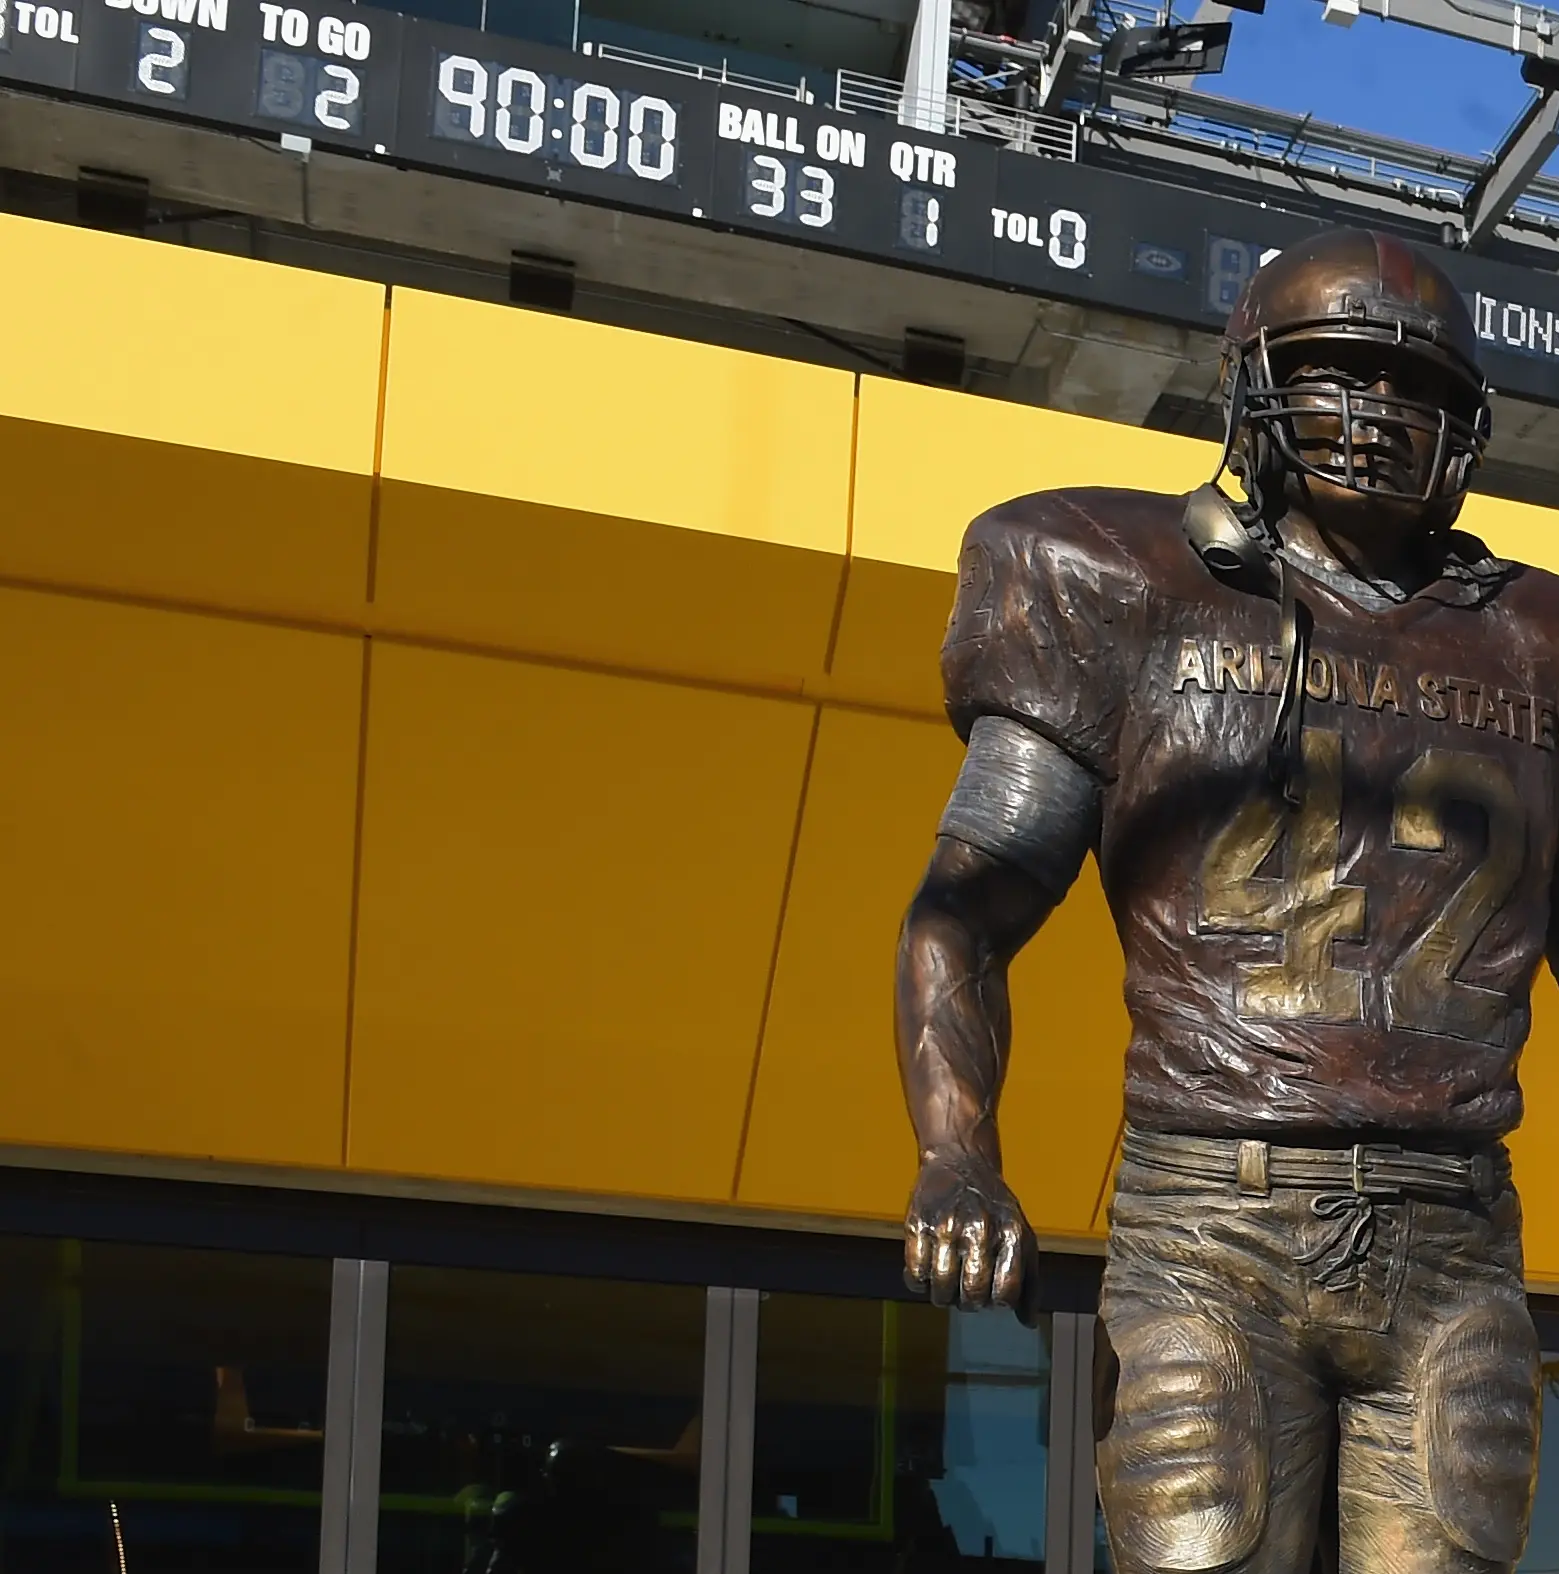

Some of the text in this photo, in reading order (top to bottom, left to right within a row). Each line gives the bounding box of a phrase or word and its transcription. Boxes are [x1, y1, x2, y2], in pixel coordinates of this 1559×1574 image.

[14, 1, 79, 43] TOL
[260, 3, 371, 60] TO GO
[138, 27, 185, 94] 2
[314, 64, 360, 130] 2
[437, 54, 678, 182] 90:00
[719, 103, 866, 168] BALL ON
[890, 142, 956, 188] QTR
[750, 155, 835, 228] 33
[925, 198, 940, 247] 1
[991, 208, 1044, 247] TOL
[1048, 209, 1087, 270] 0
[1416, 671, 1559, 750] STATE
[1194, 724, 1523, 1050] 42
